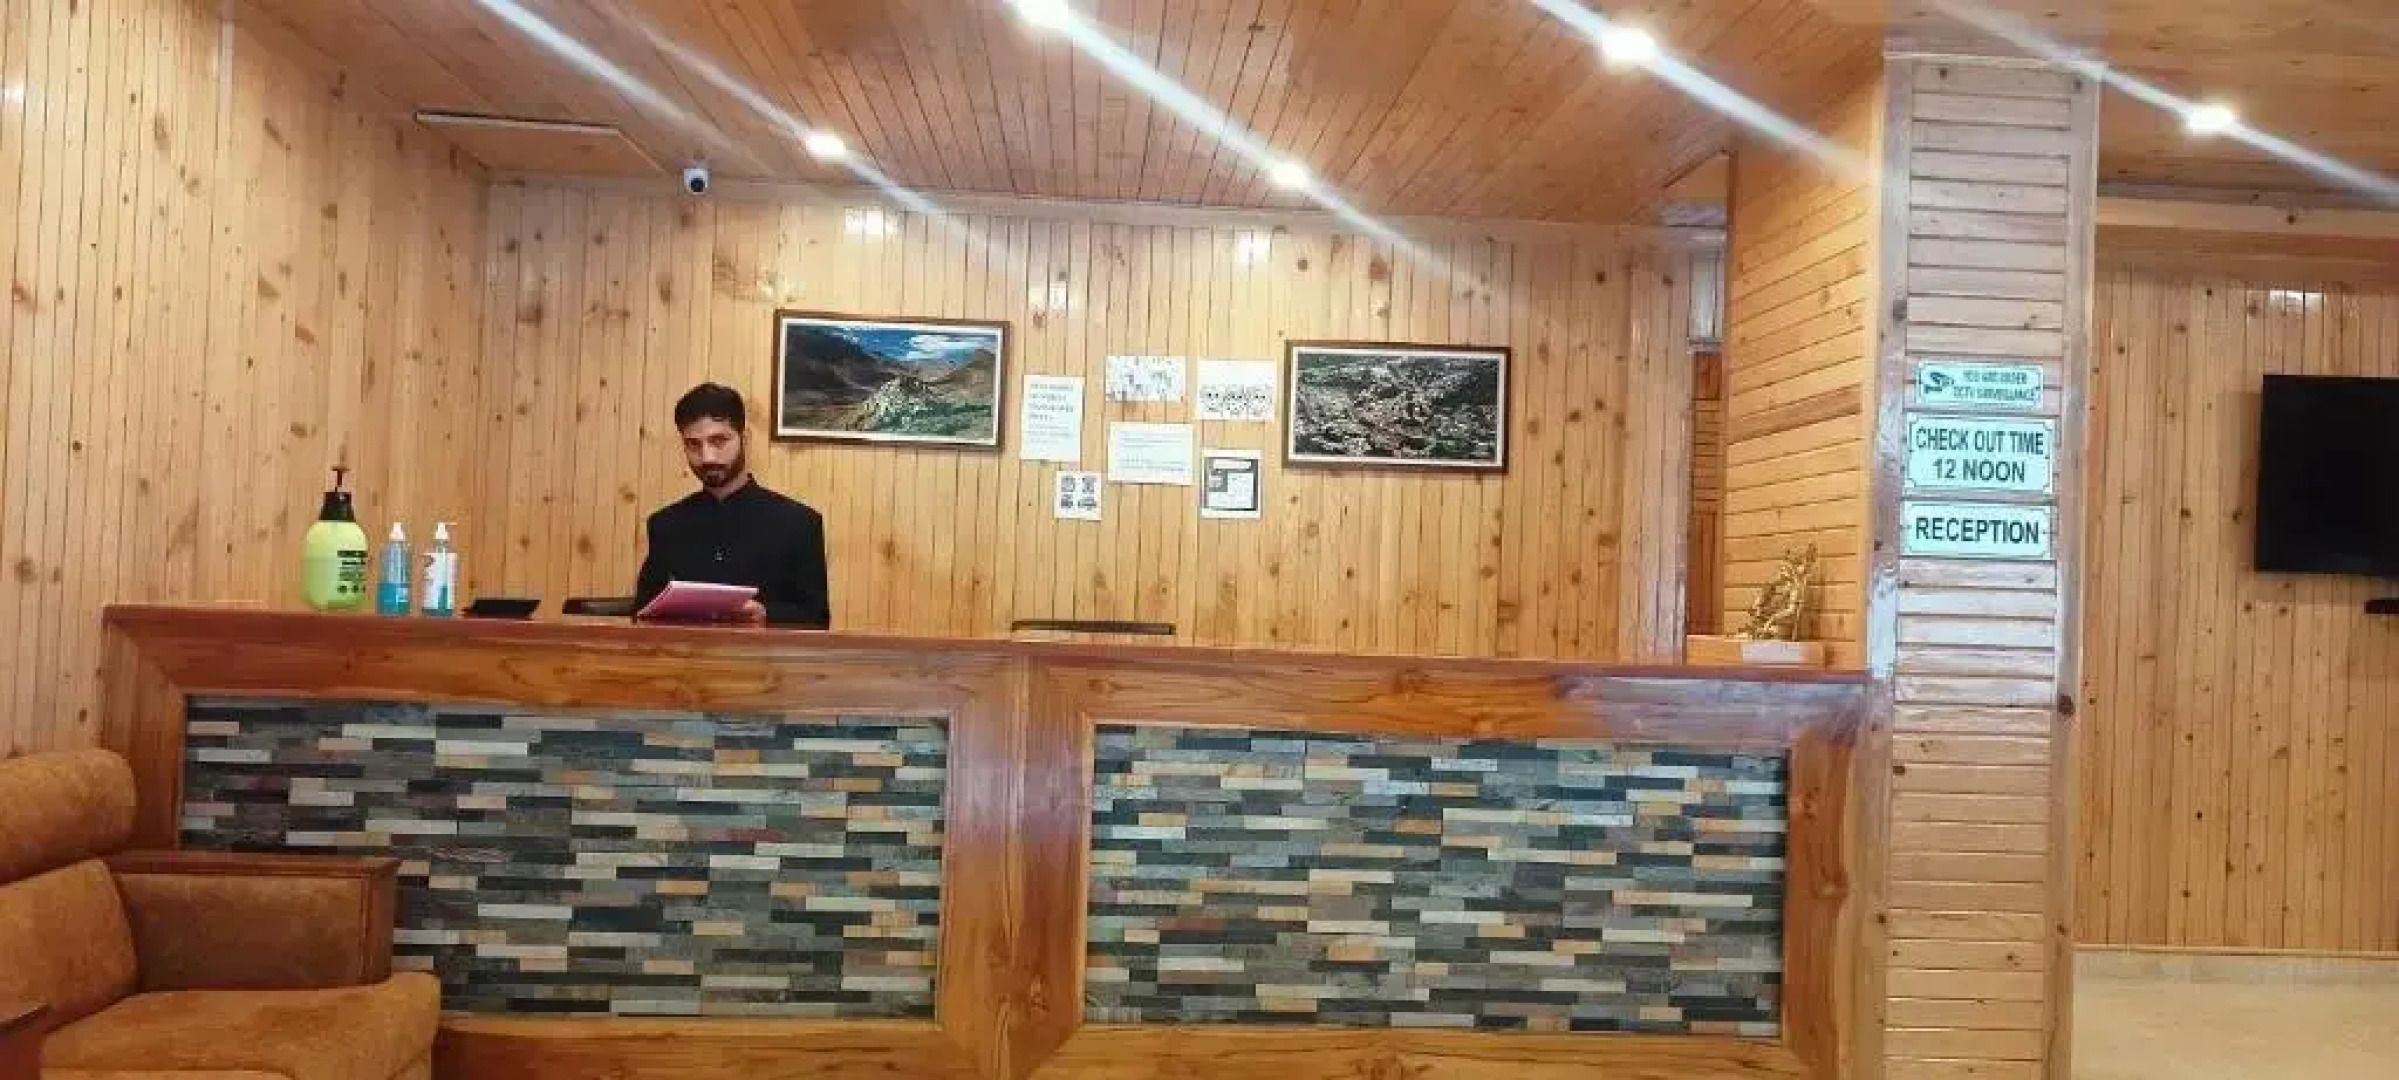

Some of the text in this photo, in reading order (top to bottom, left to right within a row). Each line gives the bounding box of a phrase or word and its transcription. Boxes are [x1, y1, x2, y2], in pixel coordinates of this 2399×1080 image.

[1916, 427, 2044, 455] CHECK OUT TIME
[1932, 458, 2025, 483] 12 NOON
[1915, 517, 2039, 544] RECEPTION
